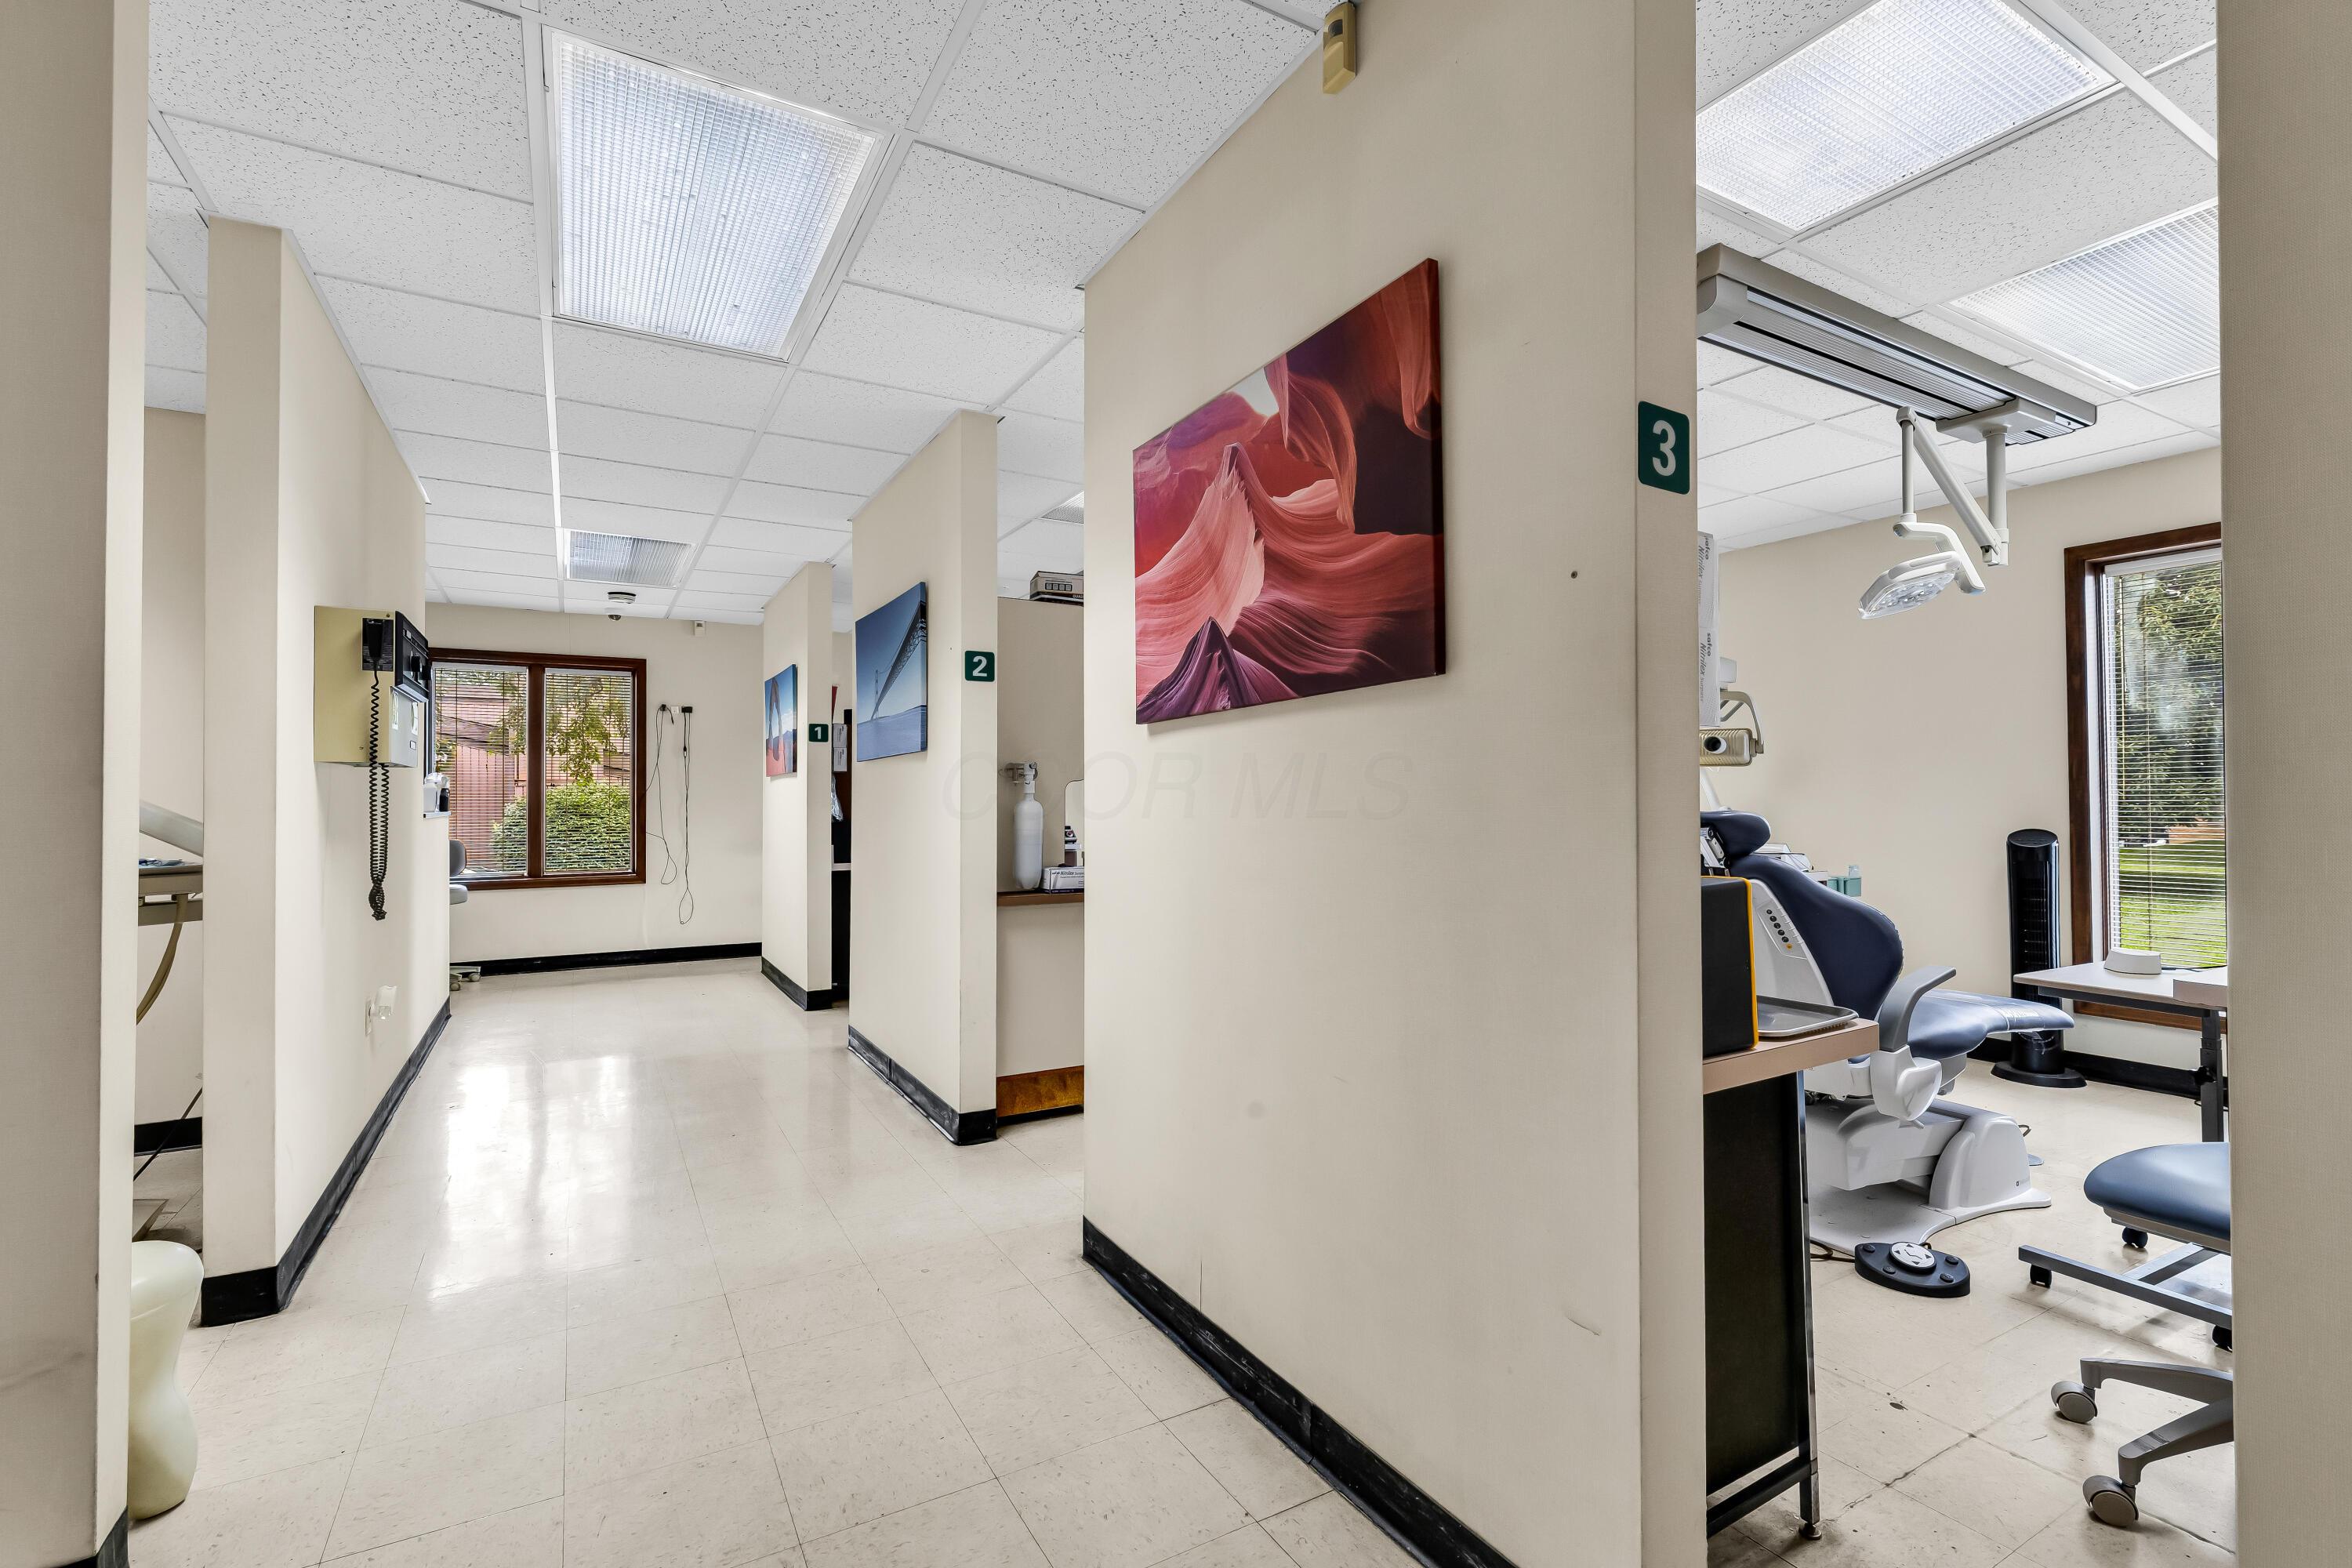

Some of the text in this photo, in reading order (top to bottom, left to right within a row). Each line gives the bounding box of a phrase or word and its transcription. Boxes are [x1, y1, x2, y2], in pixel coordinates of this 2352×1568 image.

[1652, 419, 1676, 477] 3
[972, 655, 987, 677] 2
[815, 726, 822, 739] 1
